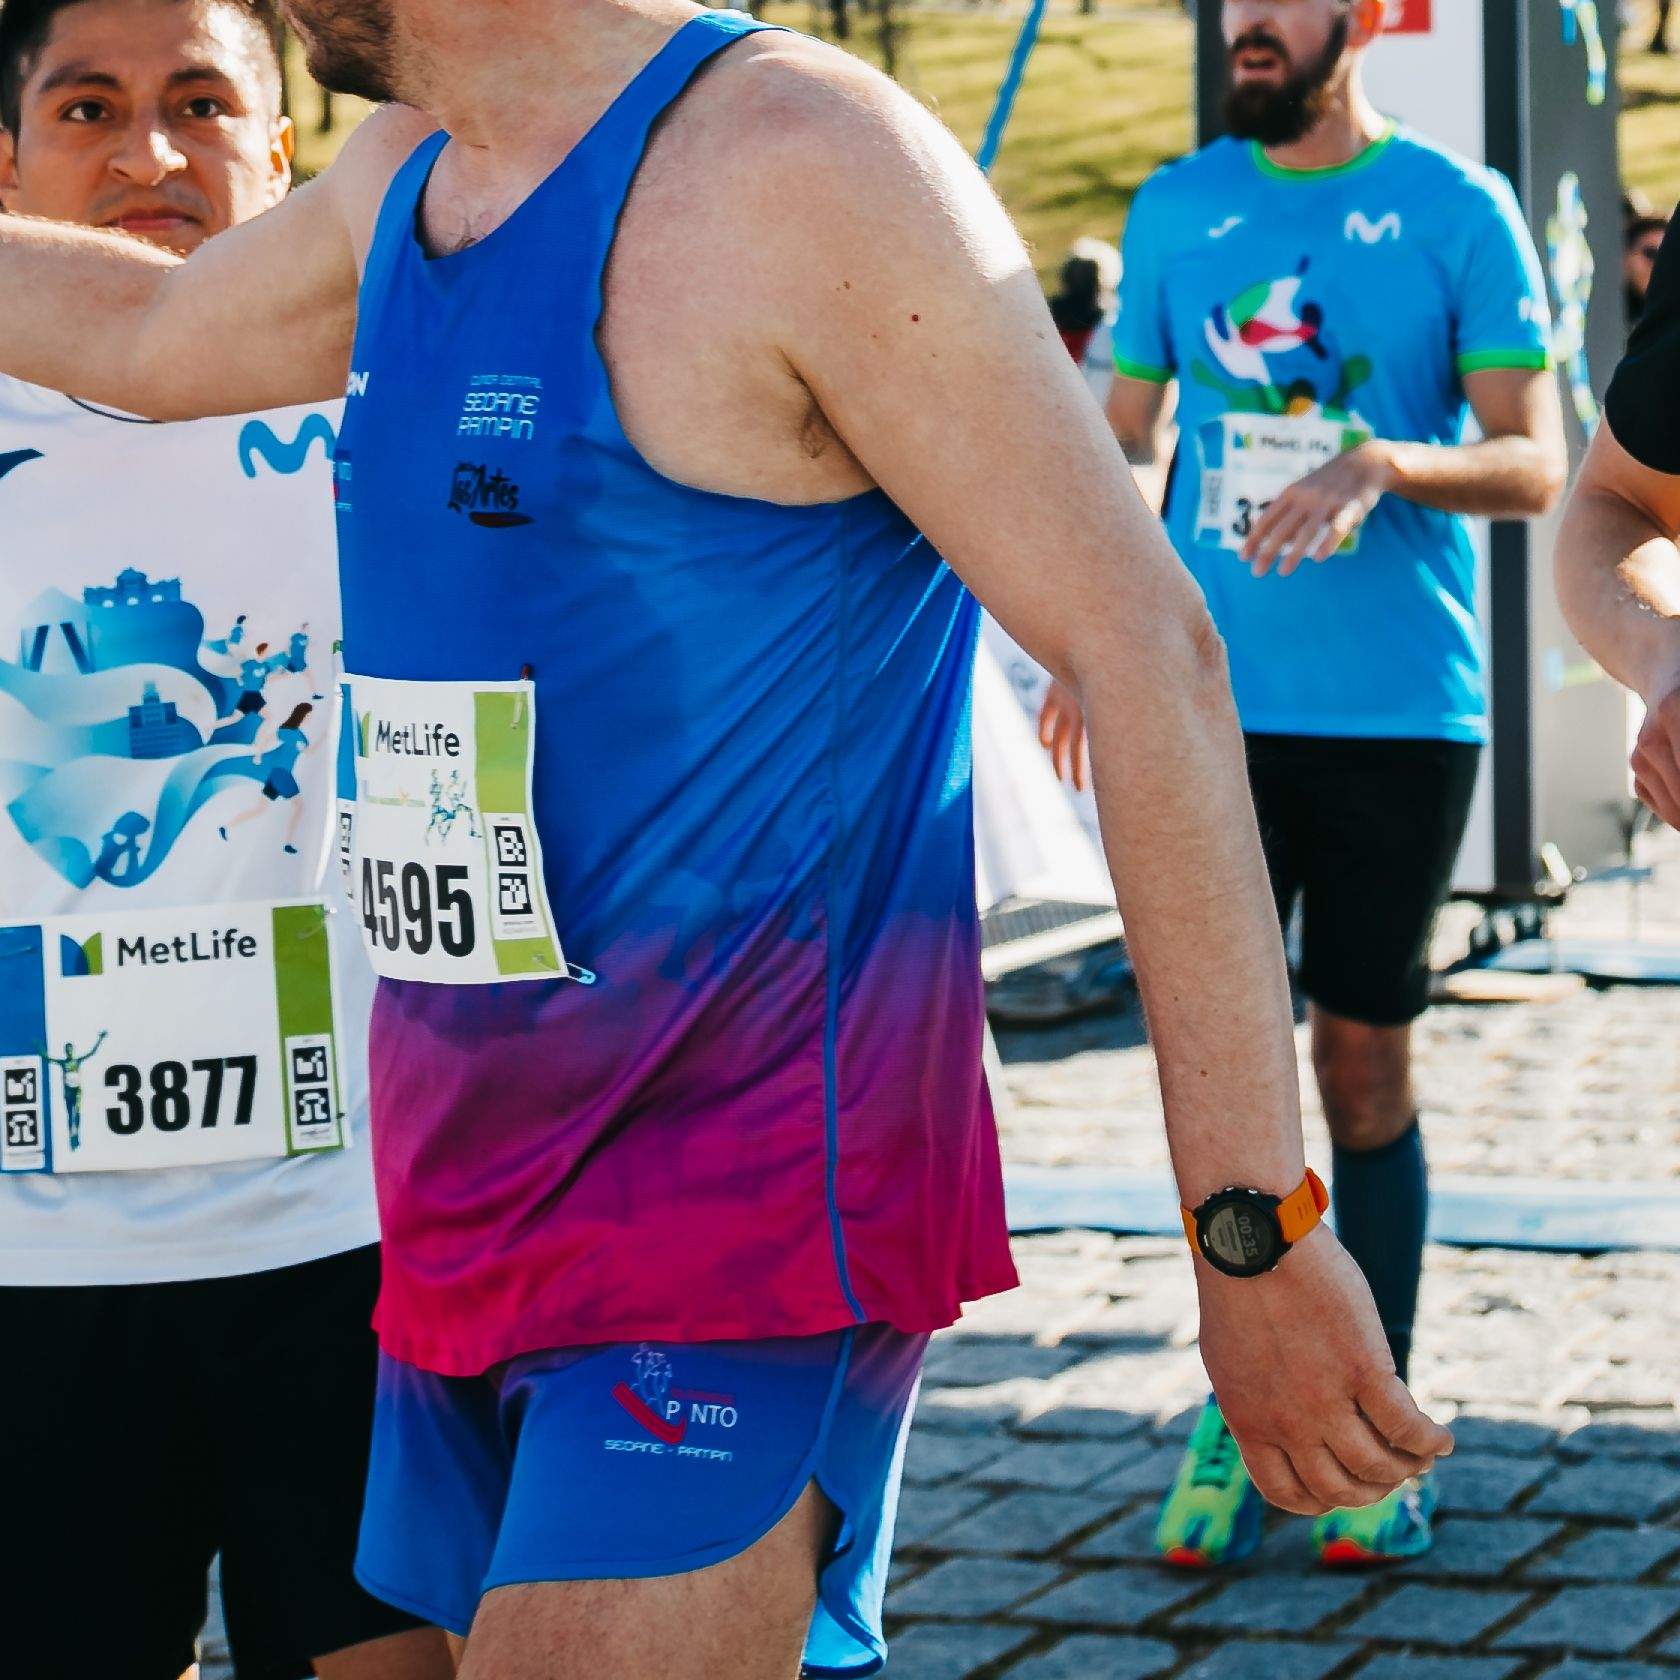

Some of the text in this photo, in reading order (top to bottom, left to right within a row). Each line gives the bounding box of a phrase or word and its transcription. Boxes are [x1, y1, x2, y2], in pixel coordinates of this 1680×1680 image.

[375, 720, 460, 757] MetLife
[362, 857, 475, 957] 4595
[117, 928, 257, 968] MetLife
[104, 1055, 257, 1136] 3877
[665, 1400, 738, 1428] PNTO
